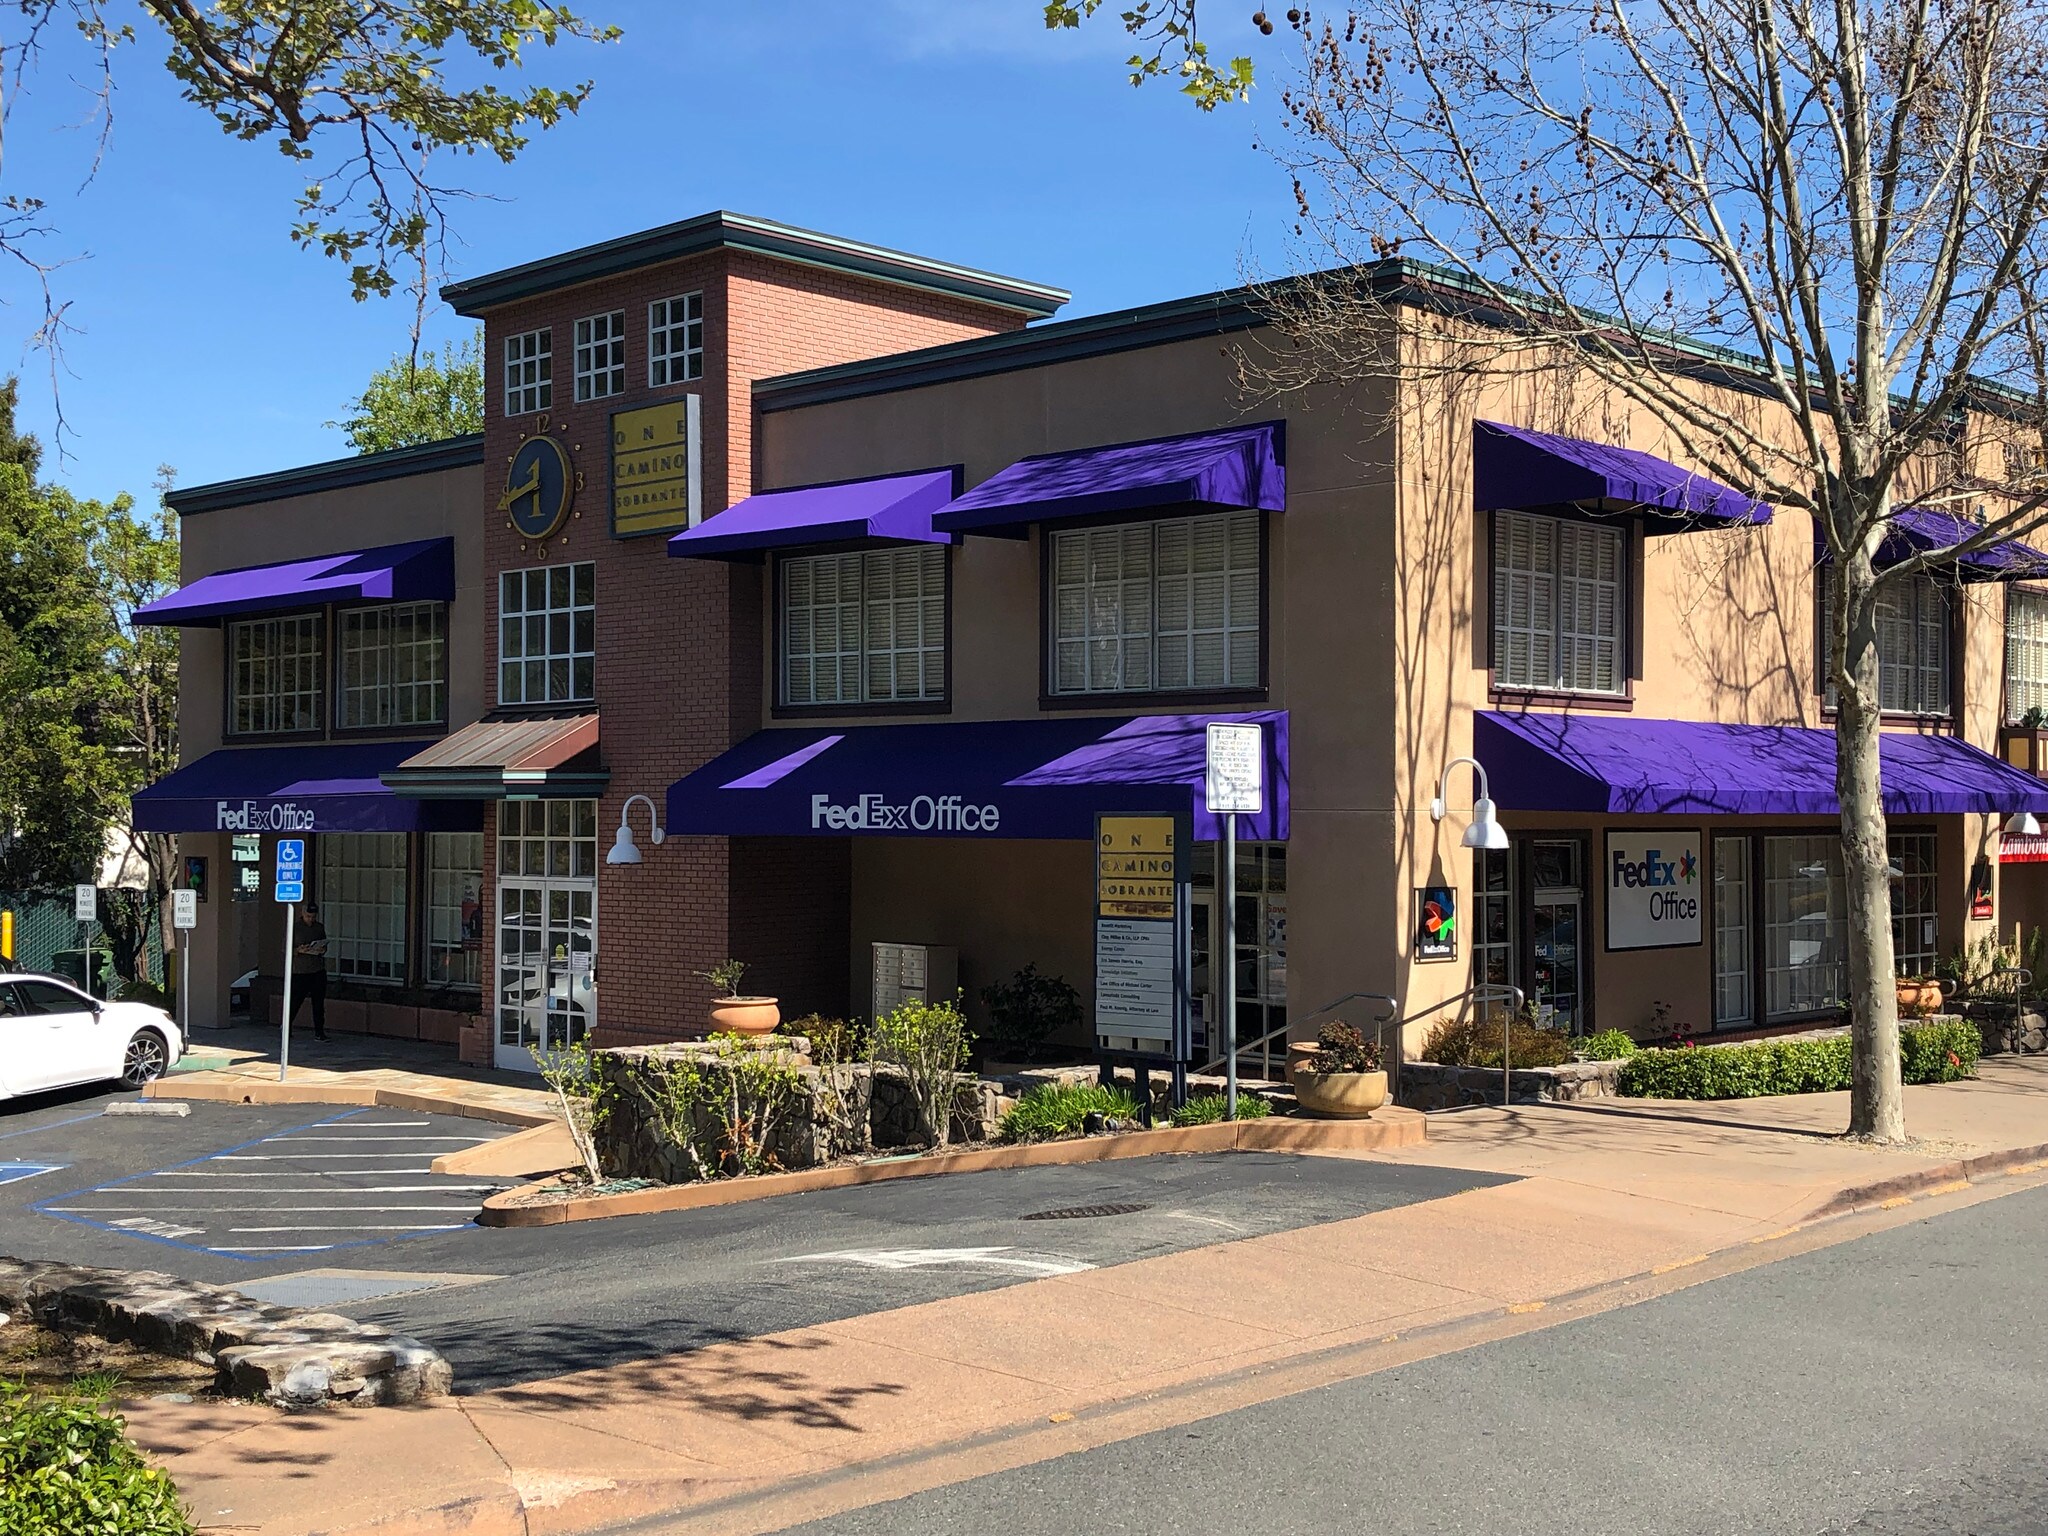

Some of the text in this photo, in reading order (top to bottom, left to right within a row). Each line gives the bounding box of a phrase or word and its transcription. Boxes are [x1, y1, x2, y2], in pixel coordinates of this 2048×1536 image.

[536, 414, 549, 434] 12
[616, 420, 685, 446] ONE
[616, 454, 685, 478] CAMINO
[575, 472, 584, 491] 3
[616, 487, 686, 508] SOBRANTE
[538, 542, 546, 560] 6
[217, 801, 315, 830] FedEx Office
[811, 794, 1000, 831] FedEx Office
[1102, 834, 1172, 847] ONE
[1102, 859, 1172, 873] CAMINO
[1612, 850, 1677, 888] FedEx
[81, 888, 91, 897] 20
[180, 893, 190, 903] 20
[1650, 891, 1697, 921] Office
